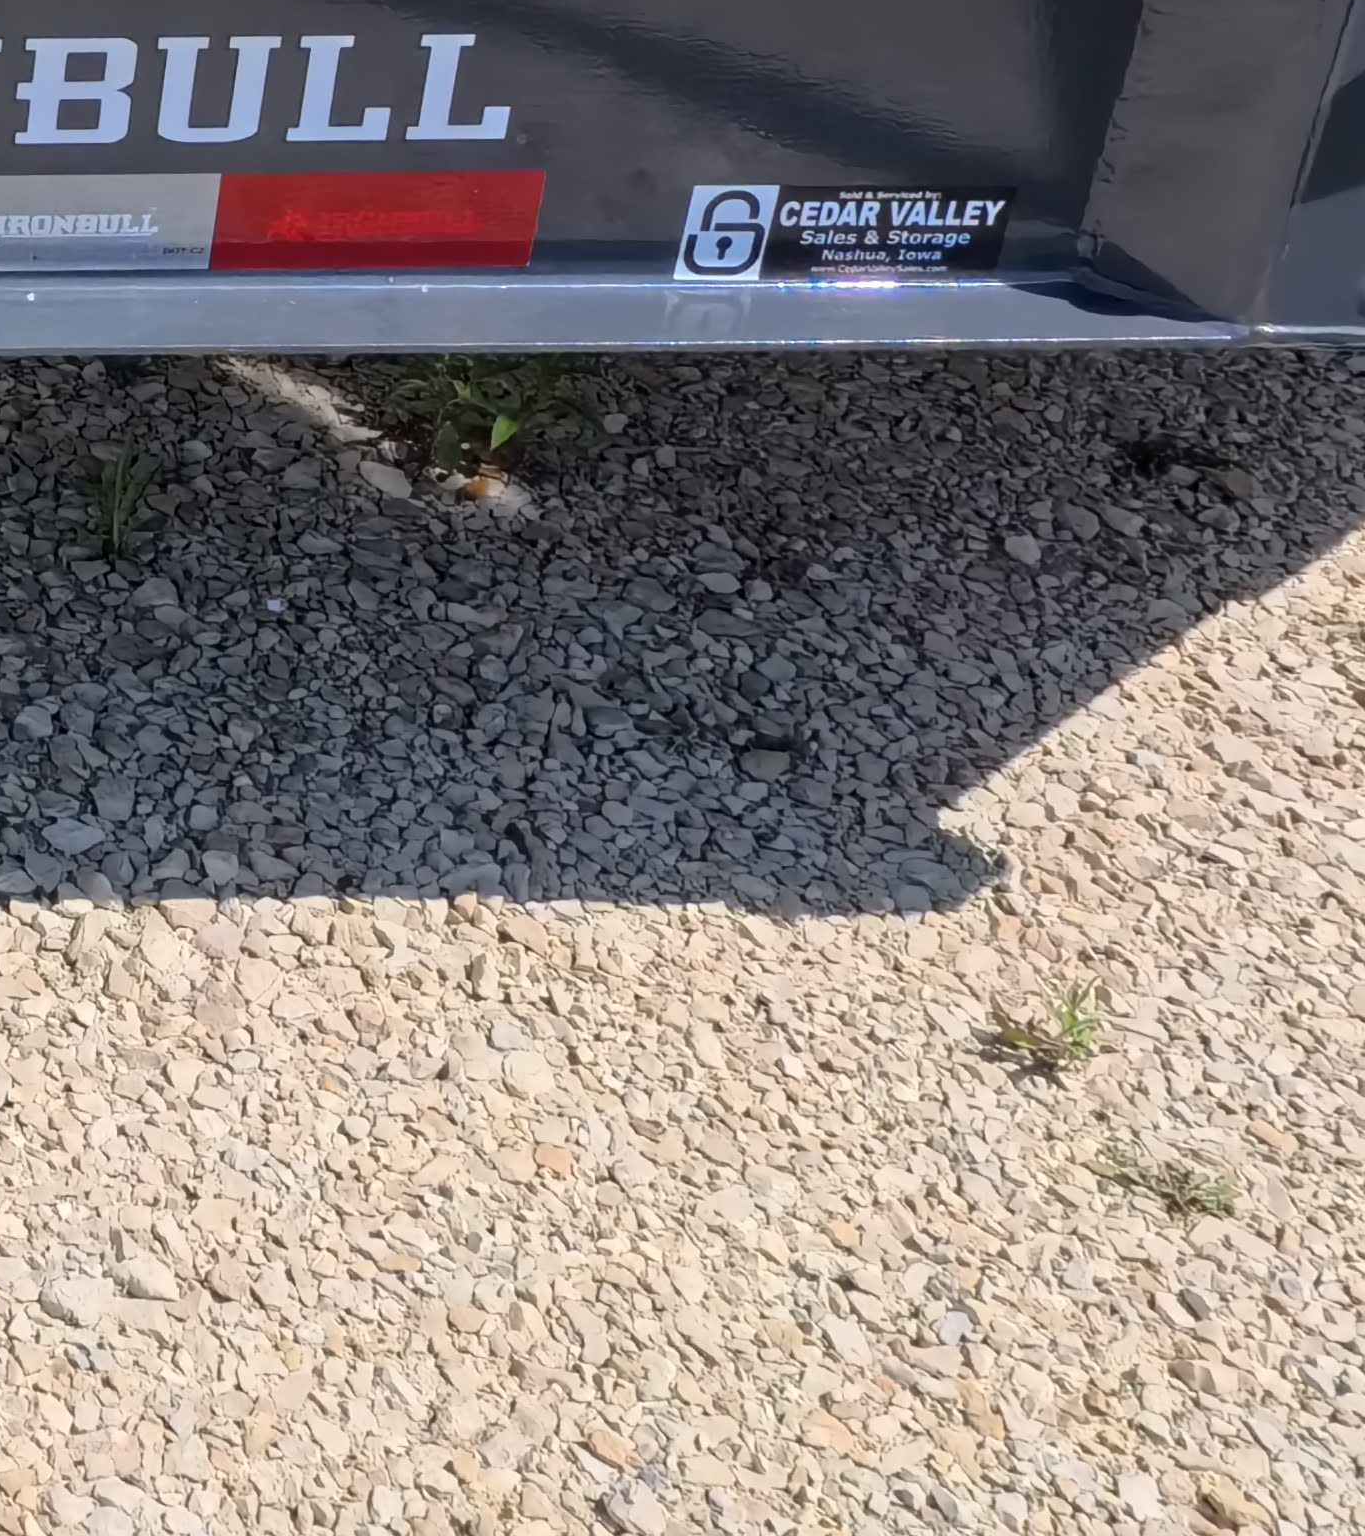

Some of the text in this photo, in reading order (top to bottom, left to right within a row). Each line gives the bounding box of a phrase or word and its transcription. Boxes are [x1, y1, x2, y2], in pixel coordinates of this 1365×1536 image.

[779, 200, 1006, 227] CEDAR VALLEY
[799, 230, 971, 247] Sales & Storage
[821, 249, 942, 263] Nashua, Iowa
